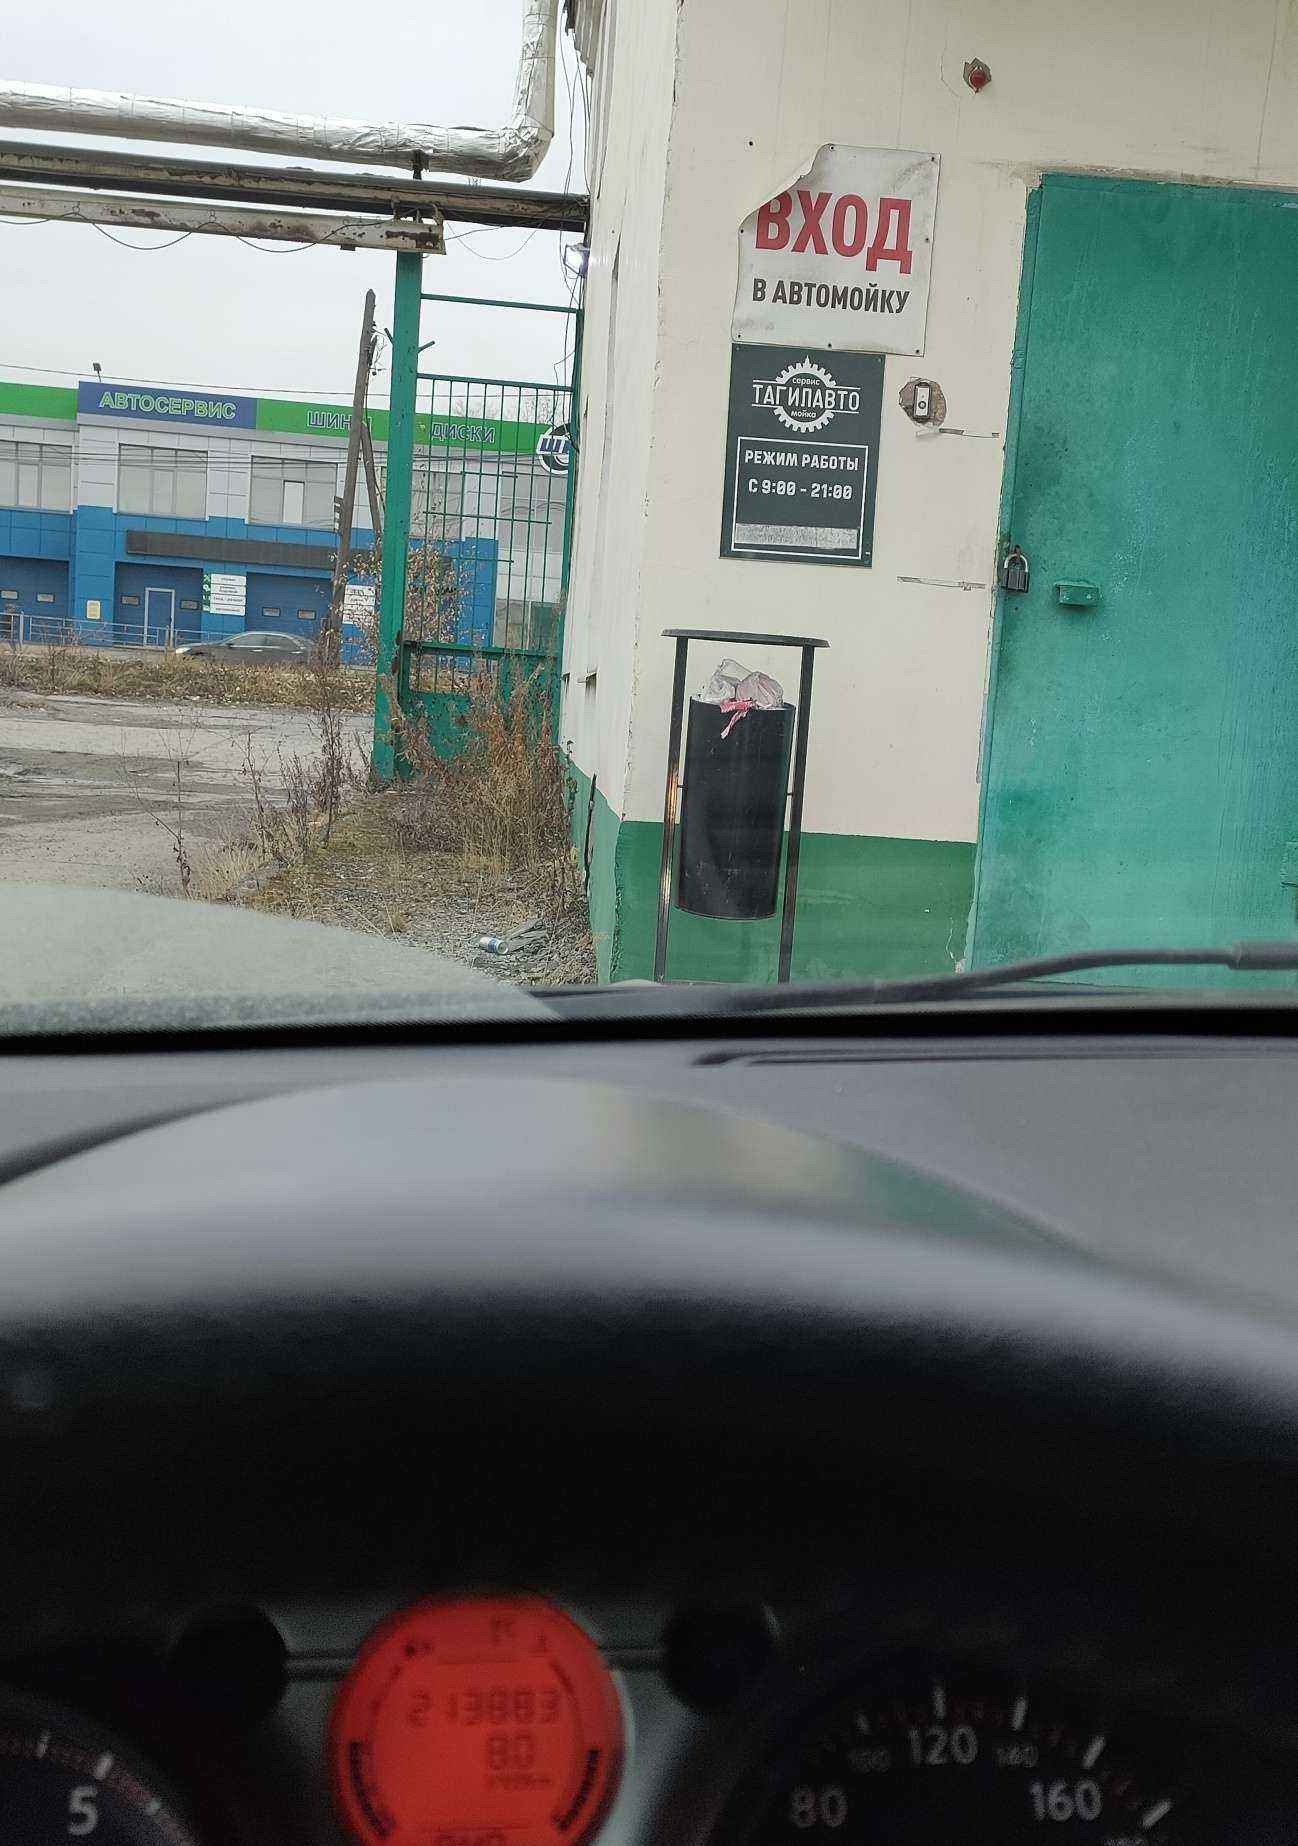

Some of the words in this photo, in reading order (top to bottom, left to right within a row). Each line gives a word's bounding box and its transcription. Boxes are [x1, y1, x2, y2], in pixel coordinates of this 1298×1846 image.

[755, 189, 912, 274] ВХОД
[752, 278, 767, 302] В
[772, 280, 910, 314] АВТОМОЙКУ
[752, 384, 860, 411] ТАГИЛАВТО
[792, 376, 820, 387] сервис
[98, 391, 237, 420] АВТОСЕРВИС
[790, 409, 817, 419] мойка
[307, 410, 373, 435] ШИН
[432, 422, 495, 443] ДИСКИ
[745, 449, 798, 467] РЕЖИМ
[801, 454, 859, 471] РАБОТЫ
[748, 479, 758, 493] С
[761, 480, 796, 496] 9:00
[811, 482, 853, 500] 21:00
[906, 1724, 979, 1766] 120
[66, 1784, 99, 1836] 5
[790, 1785, 848, 1828] 80
[1029, 1779, 1103, 1822] 160
